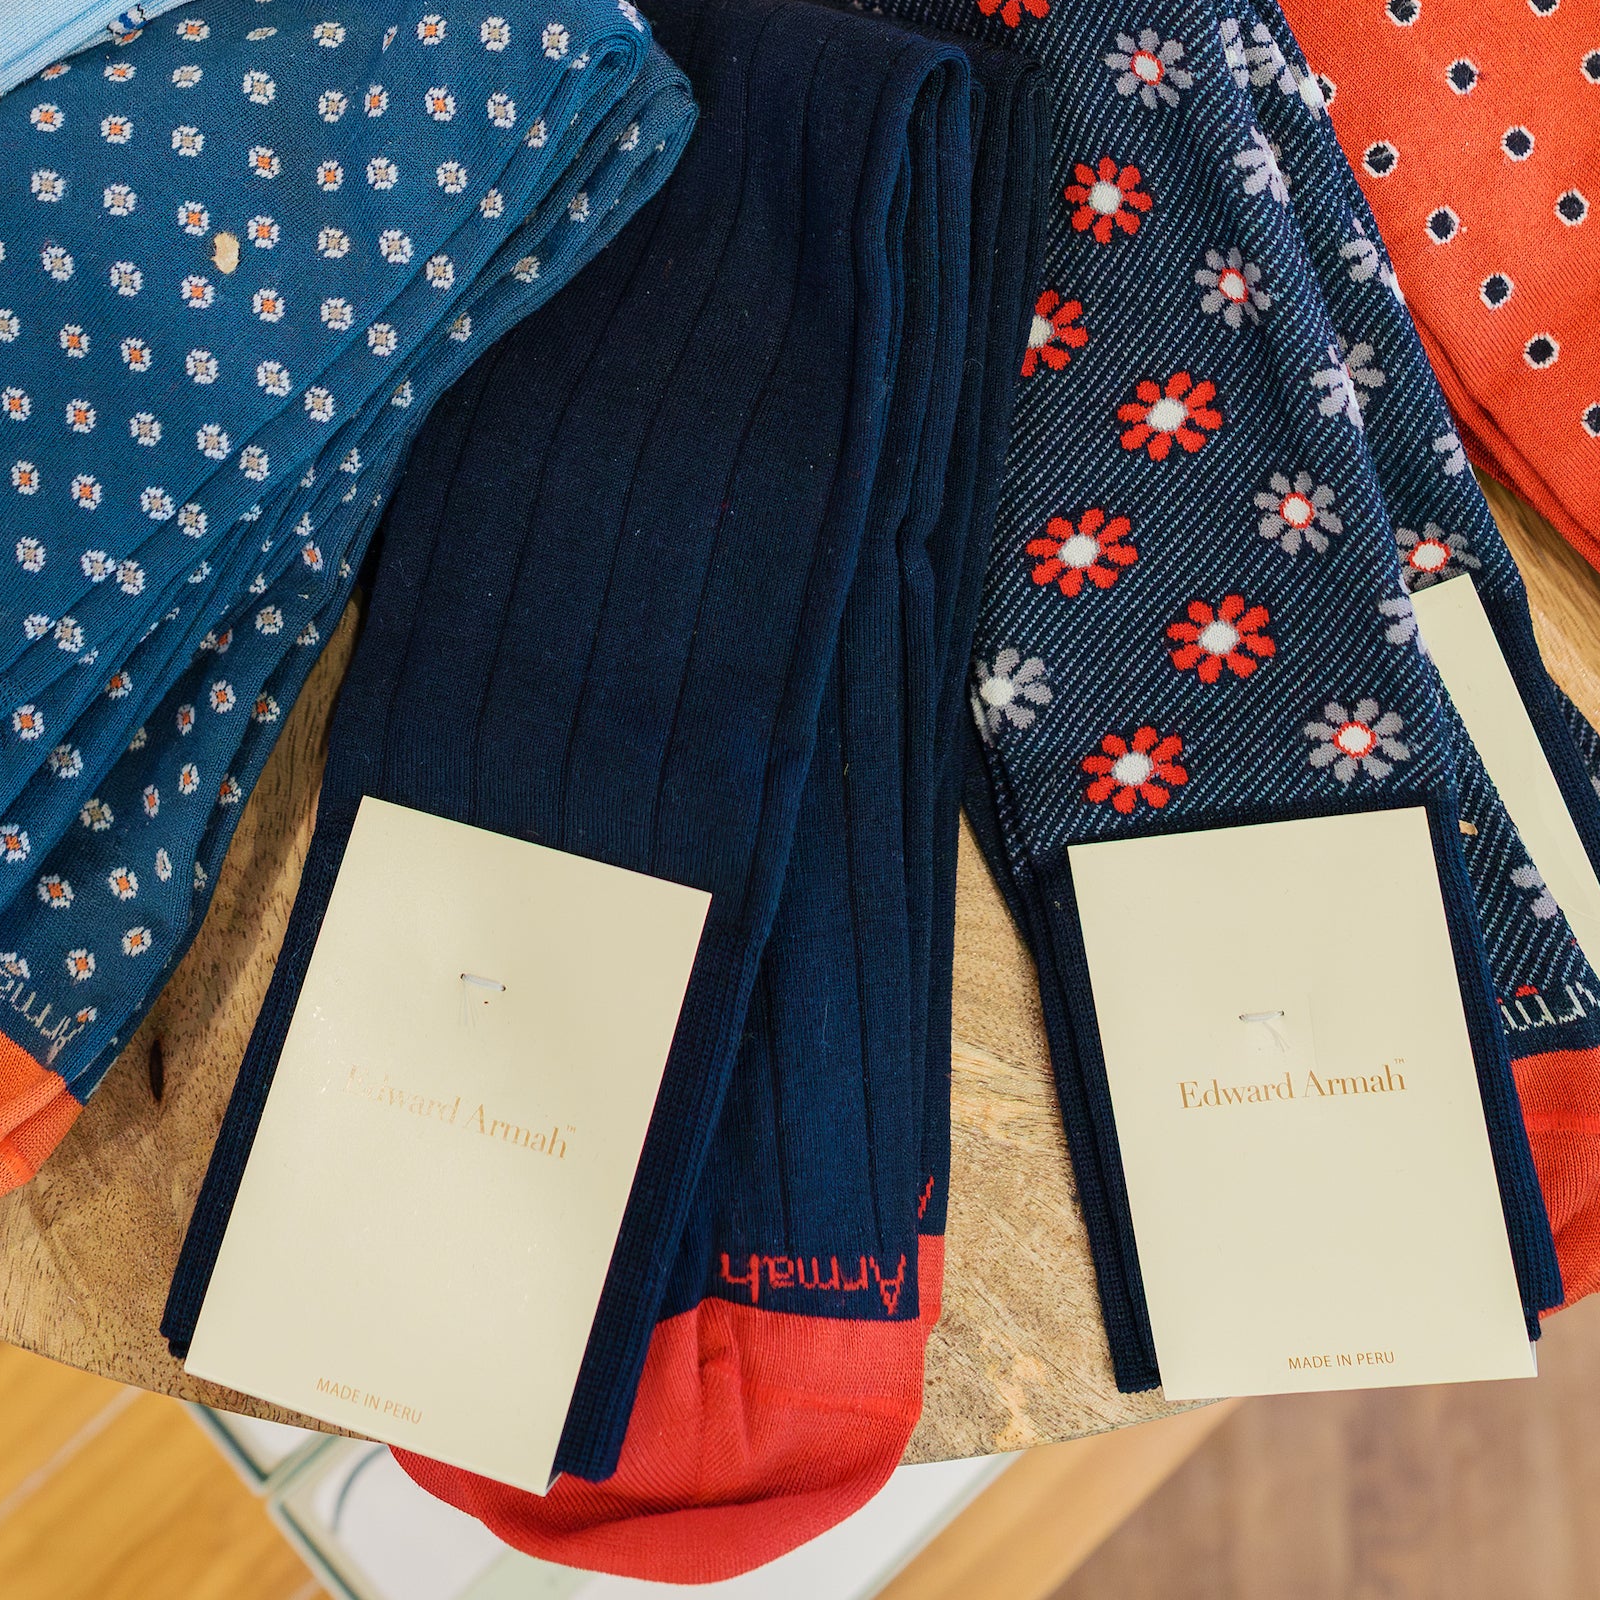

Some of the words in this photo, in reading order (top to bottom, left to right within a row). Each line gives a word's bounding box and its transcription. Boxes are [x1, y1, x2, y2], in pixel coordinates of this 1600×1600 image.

[1176, 1070, 1297, 1109] Edward
[720, 1252, 907, 1316] Armah
[1288, 1355, 1333, 1370] MADE
[1336, 1354, 1352, 1367] IN
[1356, 1351, 1395, 1366] PERU
[316, 1378, 361, 1404] MADE
[363, 1393, 381, 1411] IN
[383, 1400, 423, 1425] PERU
